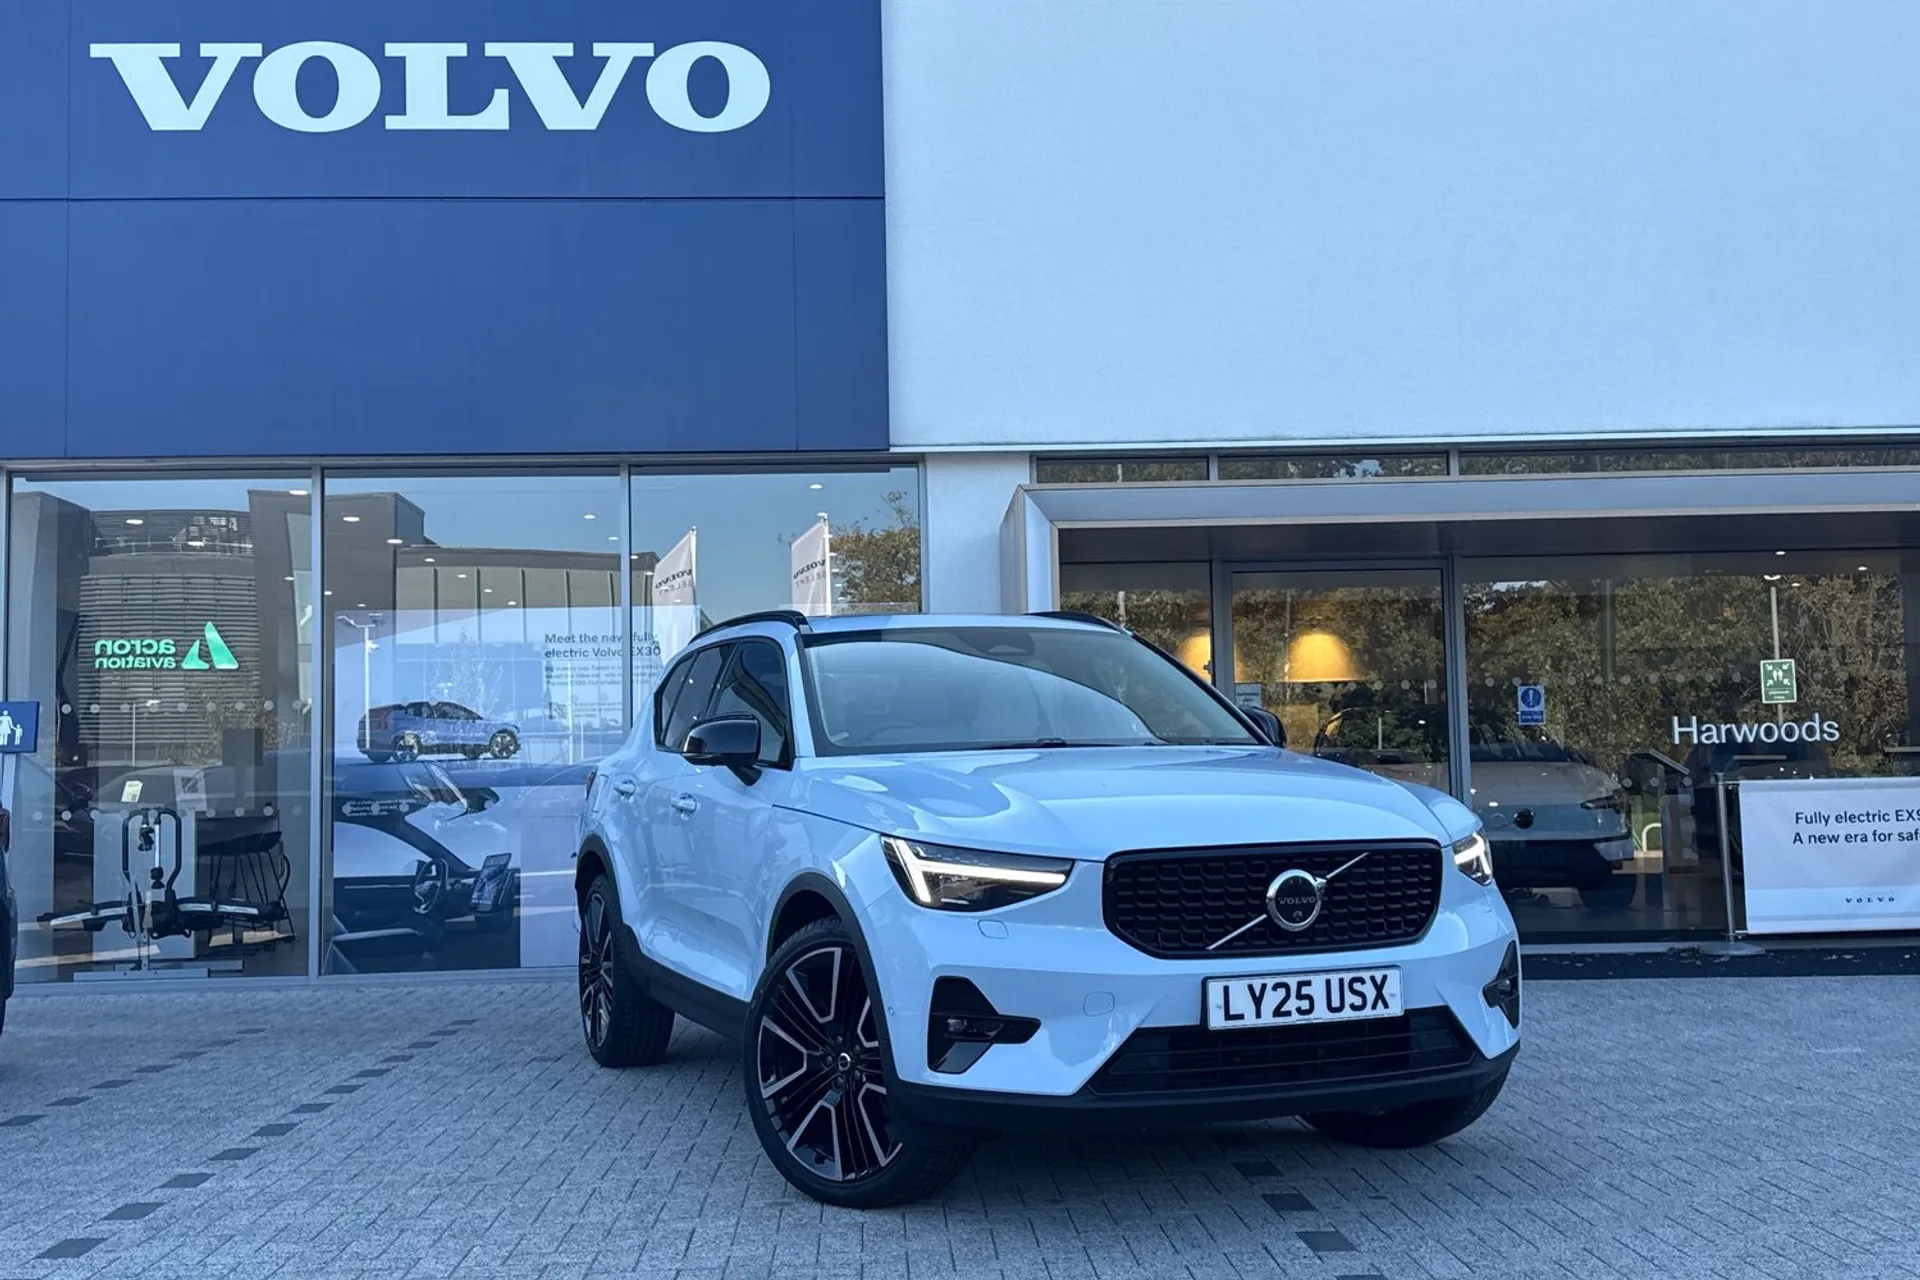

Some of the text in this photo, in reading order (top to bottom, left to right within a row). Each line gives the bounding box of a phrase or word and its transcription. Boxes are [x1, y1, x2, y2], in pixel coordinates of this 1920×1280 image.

[90, 40, 770, 133] VOLVO
[544, 633, 576, 644] Meet
[578, 633, 599, 644] the
[544, 648, 589, 658] electric
[1672, 712, 1840, 745] Harwoods
[1795, 811, 1831, 827] Fully
[1834, 809, 1891, 823] electric
[1793, 828, 1920, 845] A new era for saf
[1277, 896, 1316, 905] VOLVO
[1845, 896, 1895, 904] VOLVO
[1222, 974, 1390, 1022] LY25 USX
